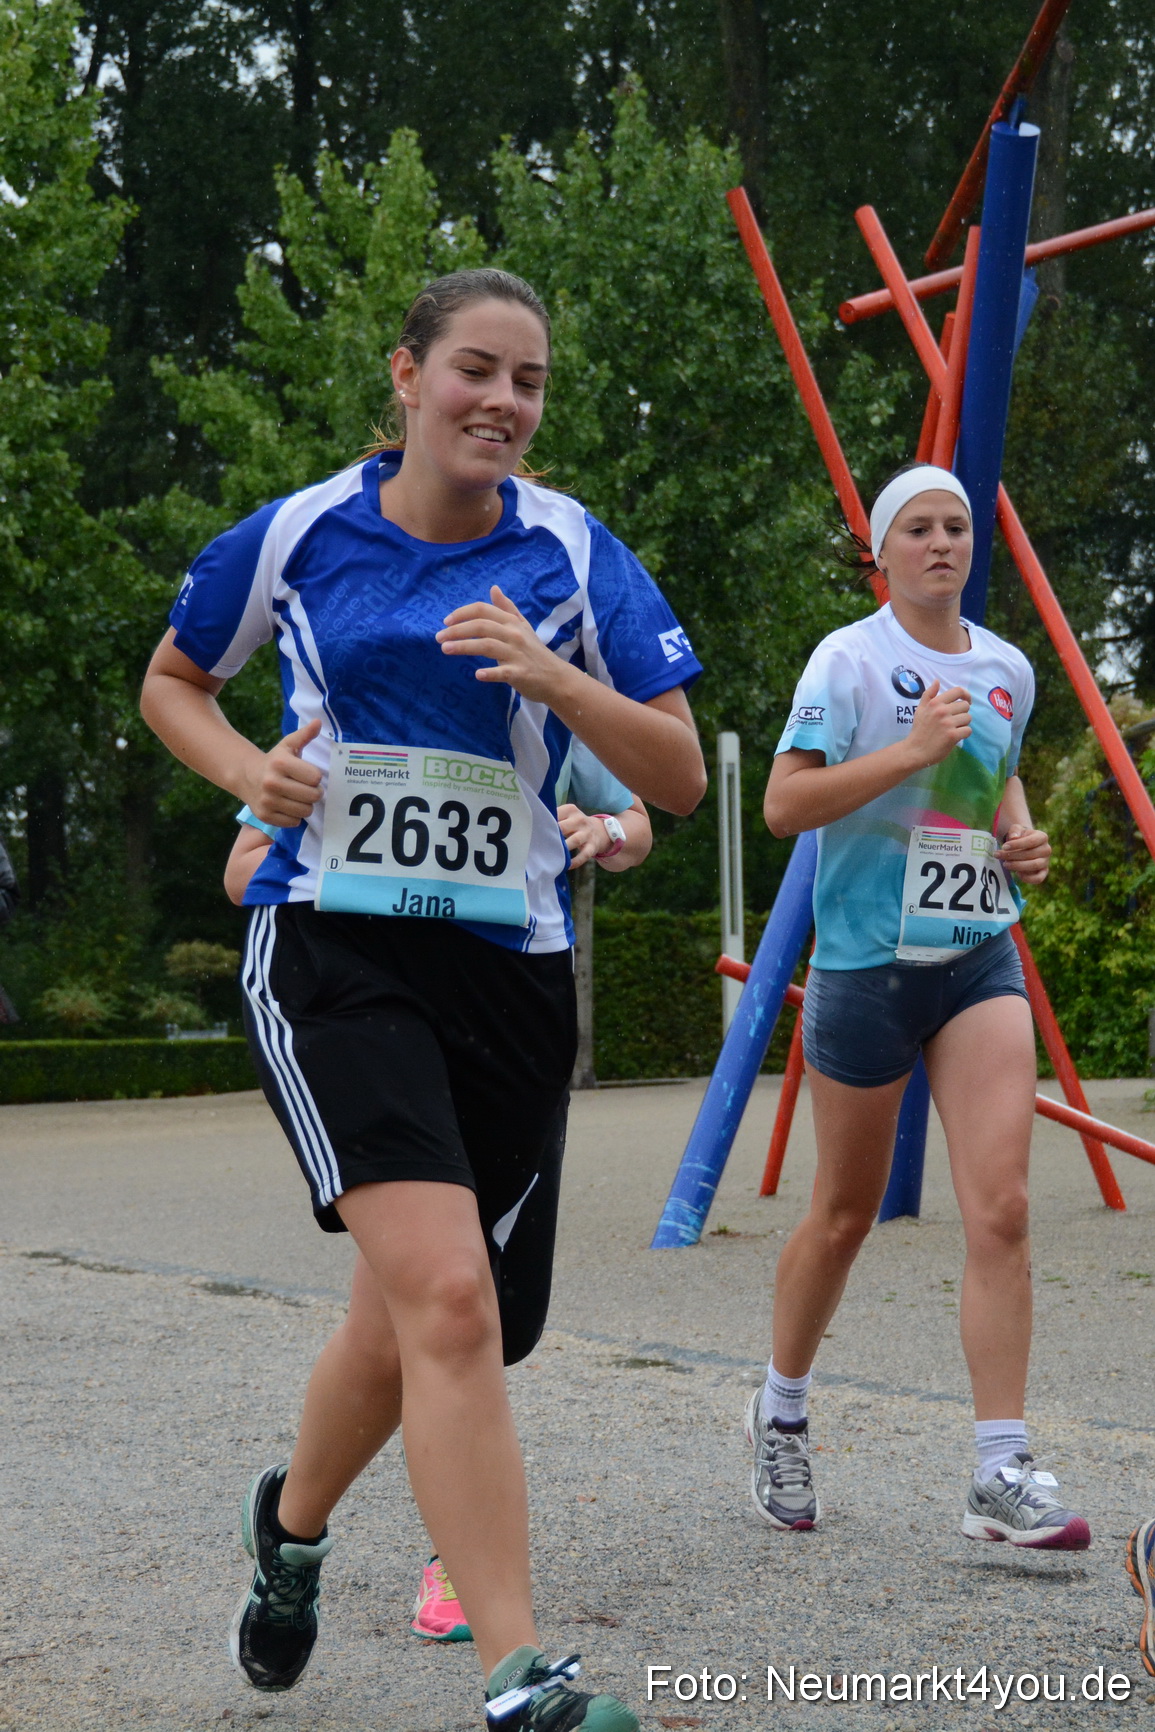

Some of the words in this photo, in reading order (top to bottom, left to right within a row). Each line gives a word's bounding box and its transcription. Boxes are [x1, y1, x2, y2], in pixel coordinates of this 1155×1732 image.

[344, 766, 410, 780] NeuerMarkt
[423, 756, 520, 792] BOCK
[422, 780, 452, 790] inspired
[453, 783, 461, 792] by
[463, 786, 484, 794] smart
[486, 789, 520, 801] concepts
[345, 792, 512, 877] 2633
[918, 842, 963, 852] NeuerMarkt
[330, 858, 339, 870] D
[919, 860, 1011, 915] 2282
[392, 887, 456, 918] Jana
